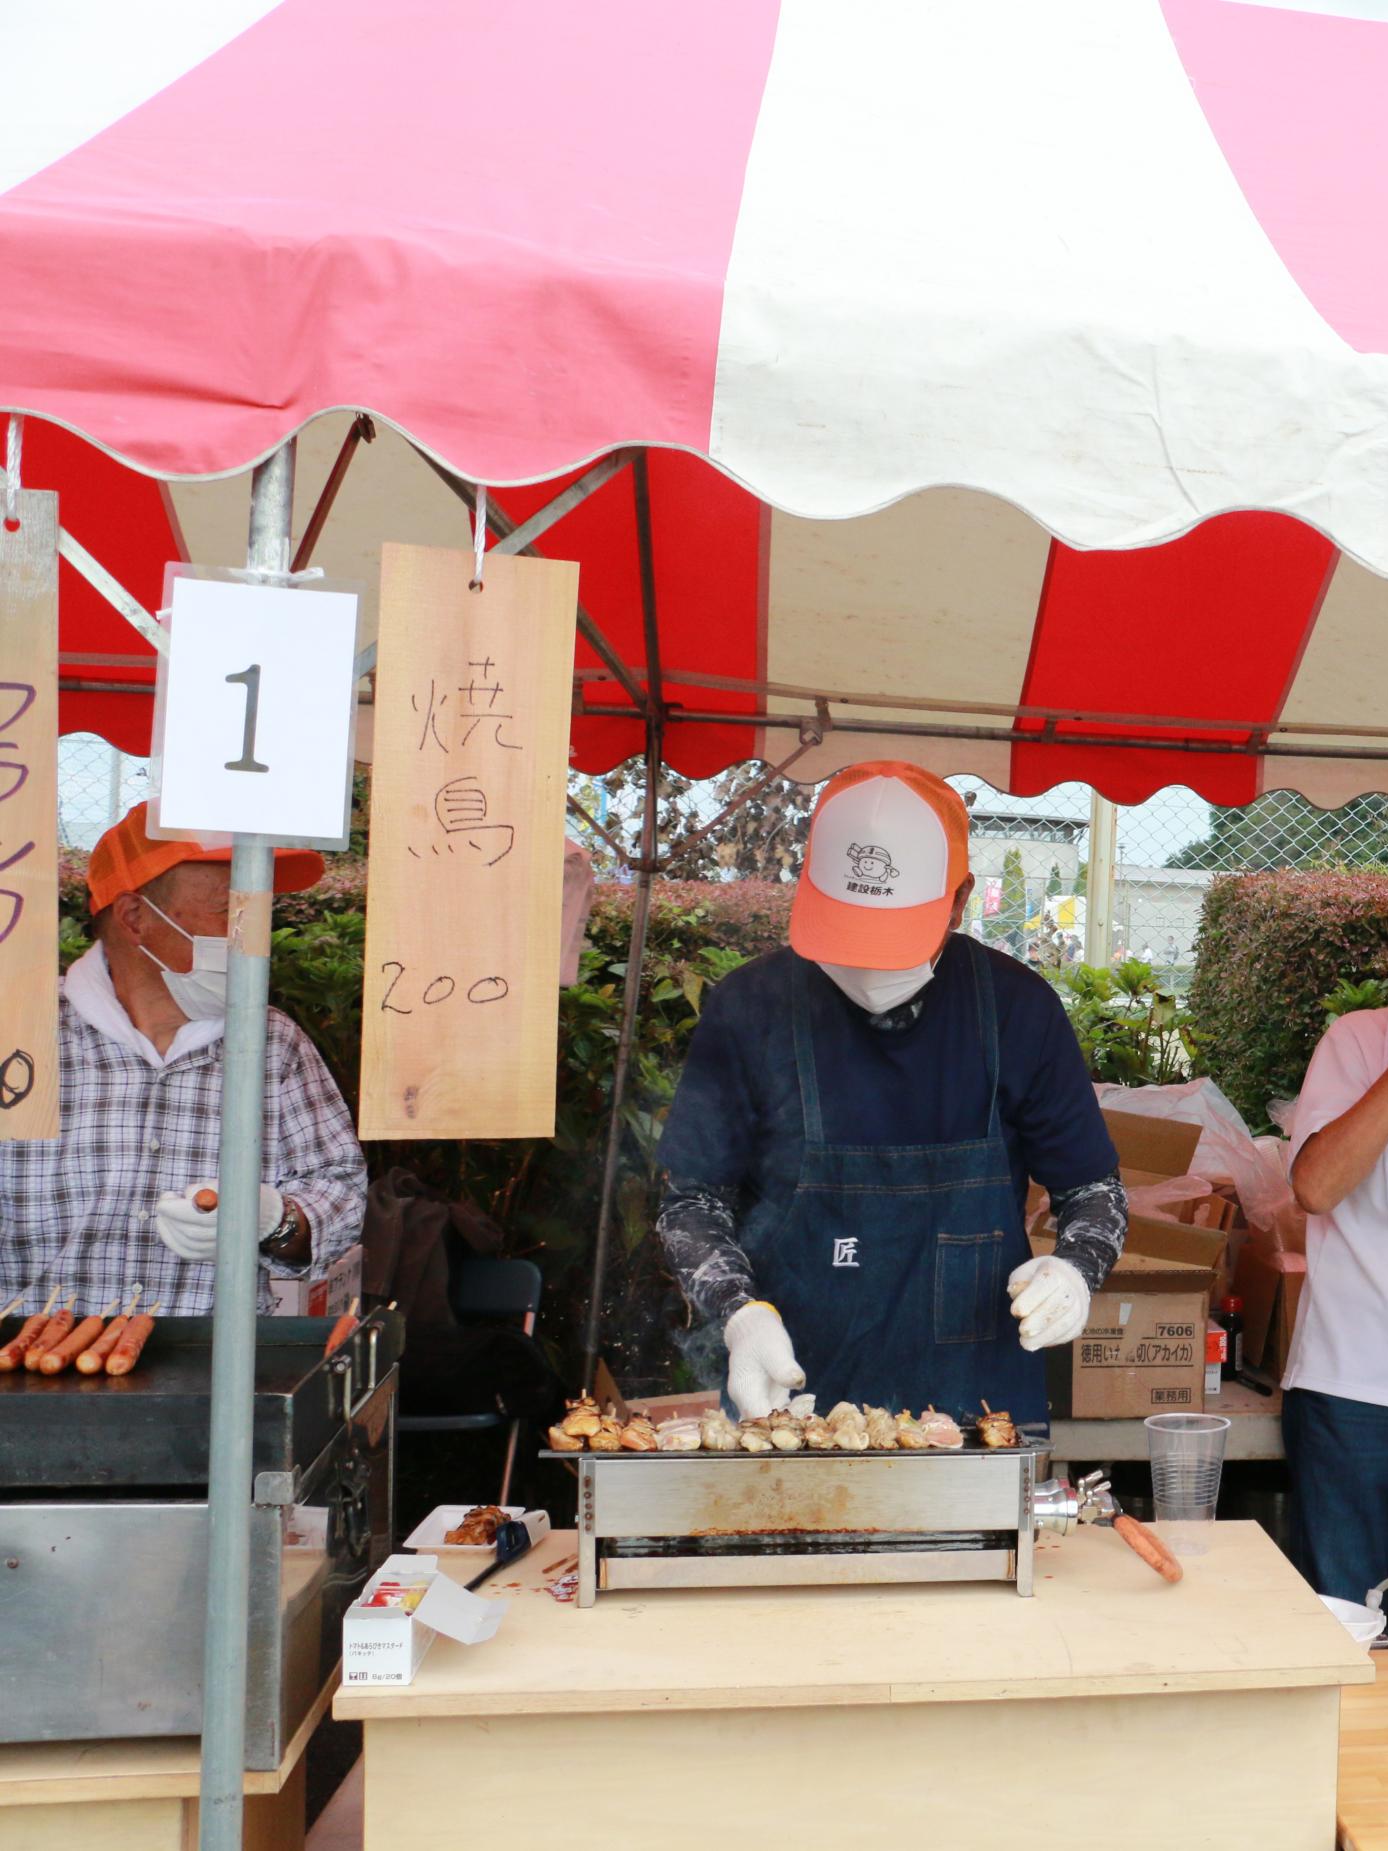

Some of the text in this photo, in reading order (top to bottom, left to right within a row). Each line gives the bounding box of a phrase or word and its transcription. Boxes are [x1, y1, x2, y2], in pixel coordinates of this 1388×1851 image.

[225, 664, 270, 774] 1
[407, 656, 523, 867] 焼鳥
[846, 881, 895, 897] 建設栃木
[380, 961, 509, 1014] 200
[832, 1237, 860, 1267] 匠
[1157, 1326, 1193, 1337] 7606
[1154, 1390, 1189, 1402] 業務用
